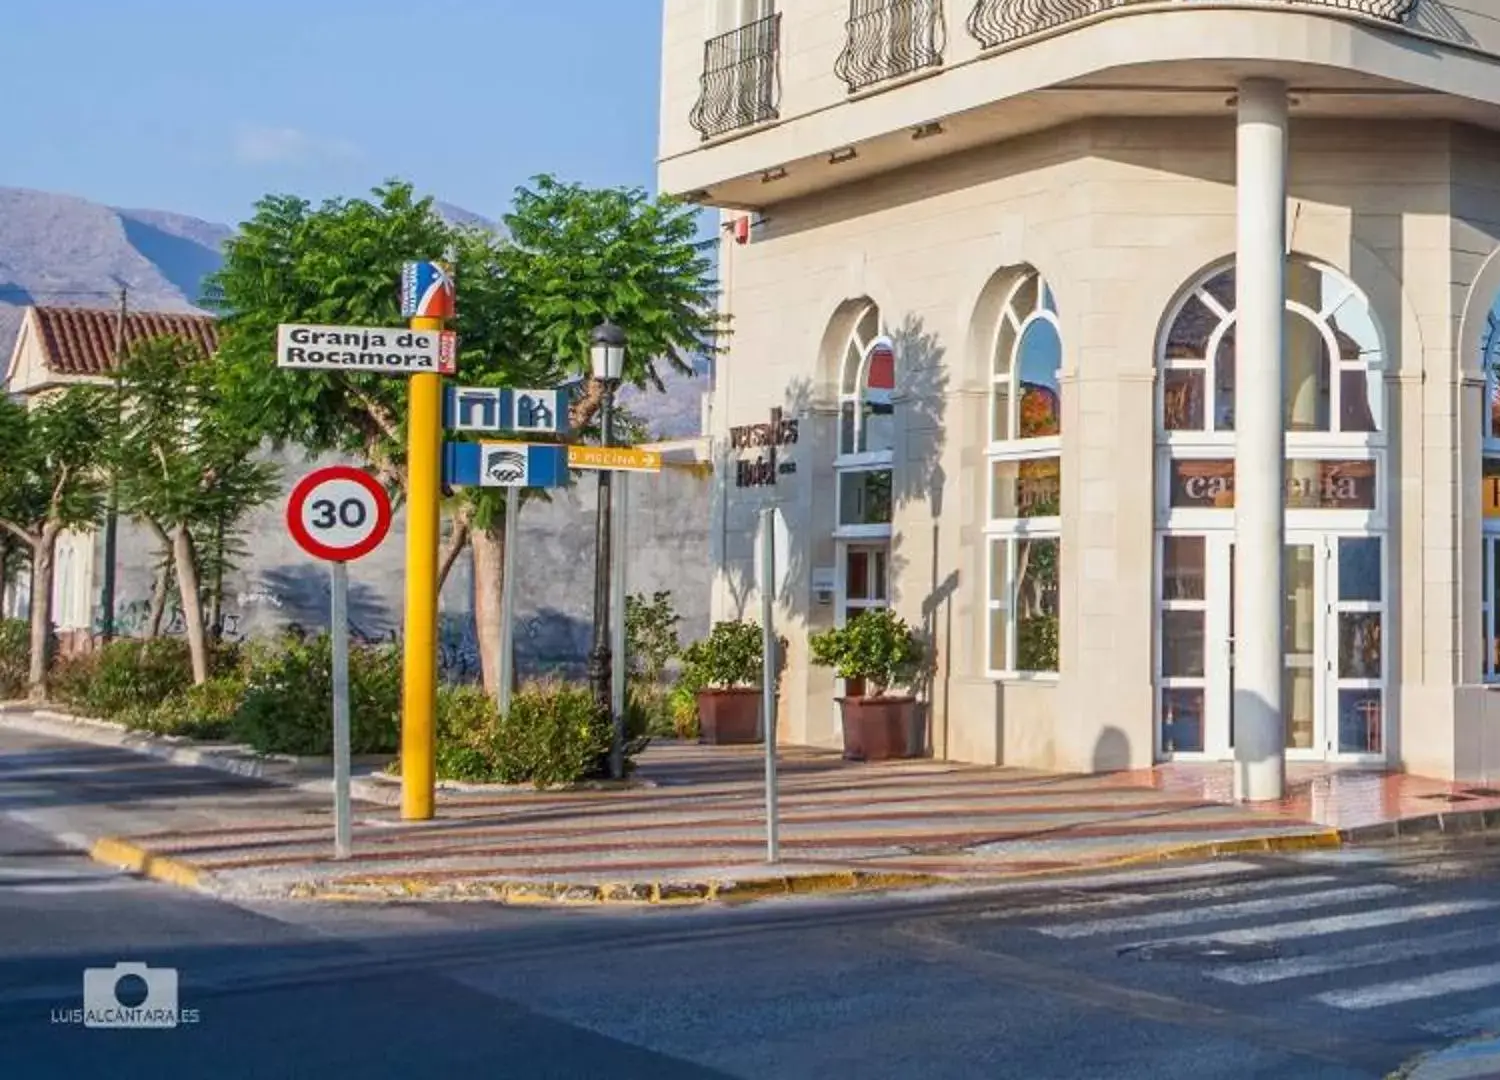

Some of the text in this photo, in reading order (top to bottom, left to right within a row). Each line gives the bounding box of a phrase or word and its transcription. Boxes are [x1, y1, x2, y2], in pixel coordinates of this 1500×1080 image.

[290, 329, 430, 350] Granja de
[287, 347, 433, 367] Rocamora
[312, 497, 367, 529] 30
